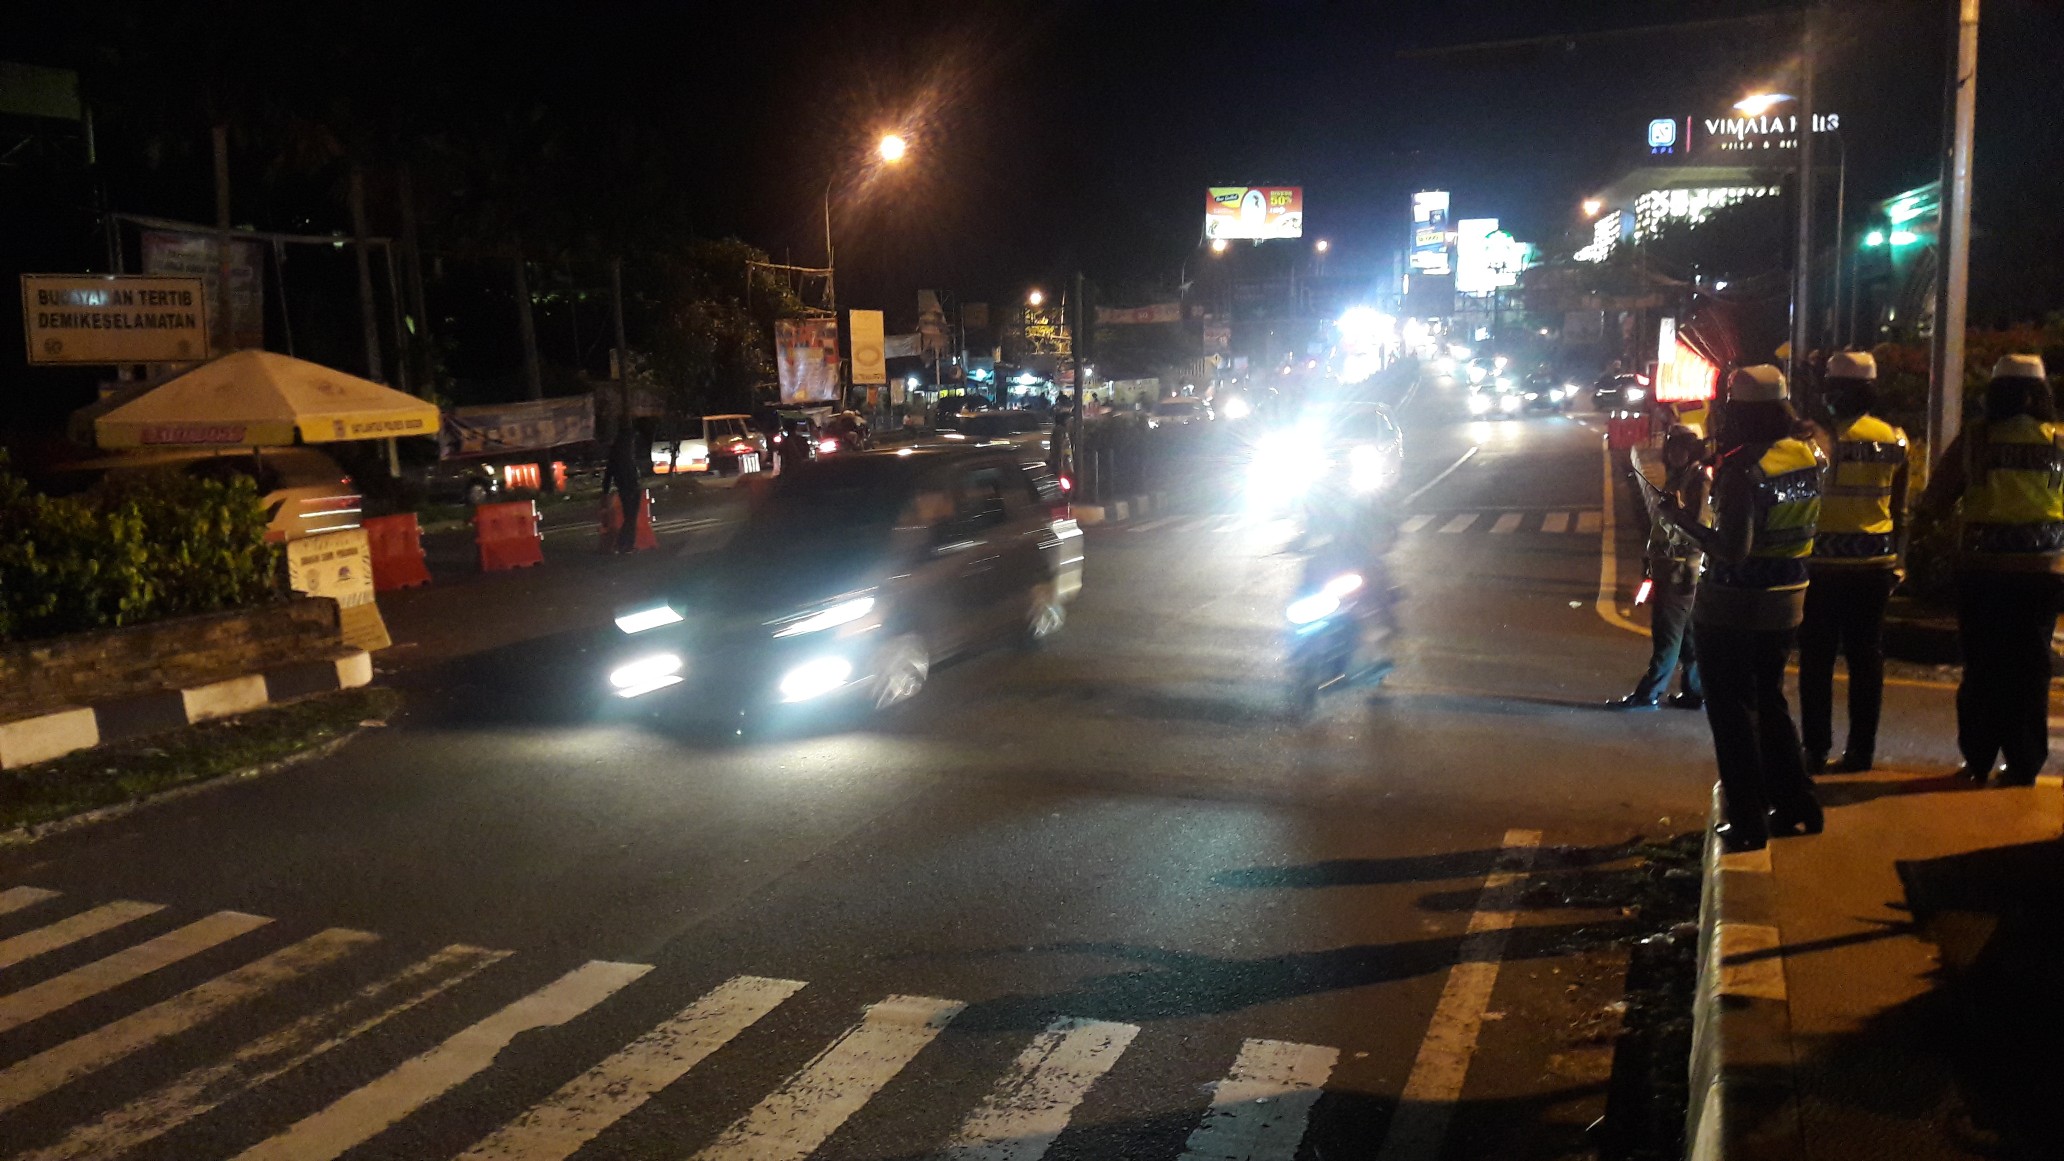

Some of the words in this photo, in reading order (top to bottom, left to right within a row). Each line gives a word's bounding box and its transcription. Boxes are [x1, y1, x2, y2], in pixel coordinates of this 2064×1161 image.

[1704, 115, 1784, 141] VIMALA
[38, 289, 133, 306] BUAYAAN
[138, 290, 193, 306] TERTIB
